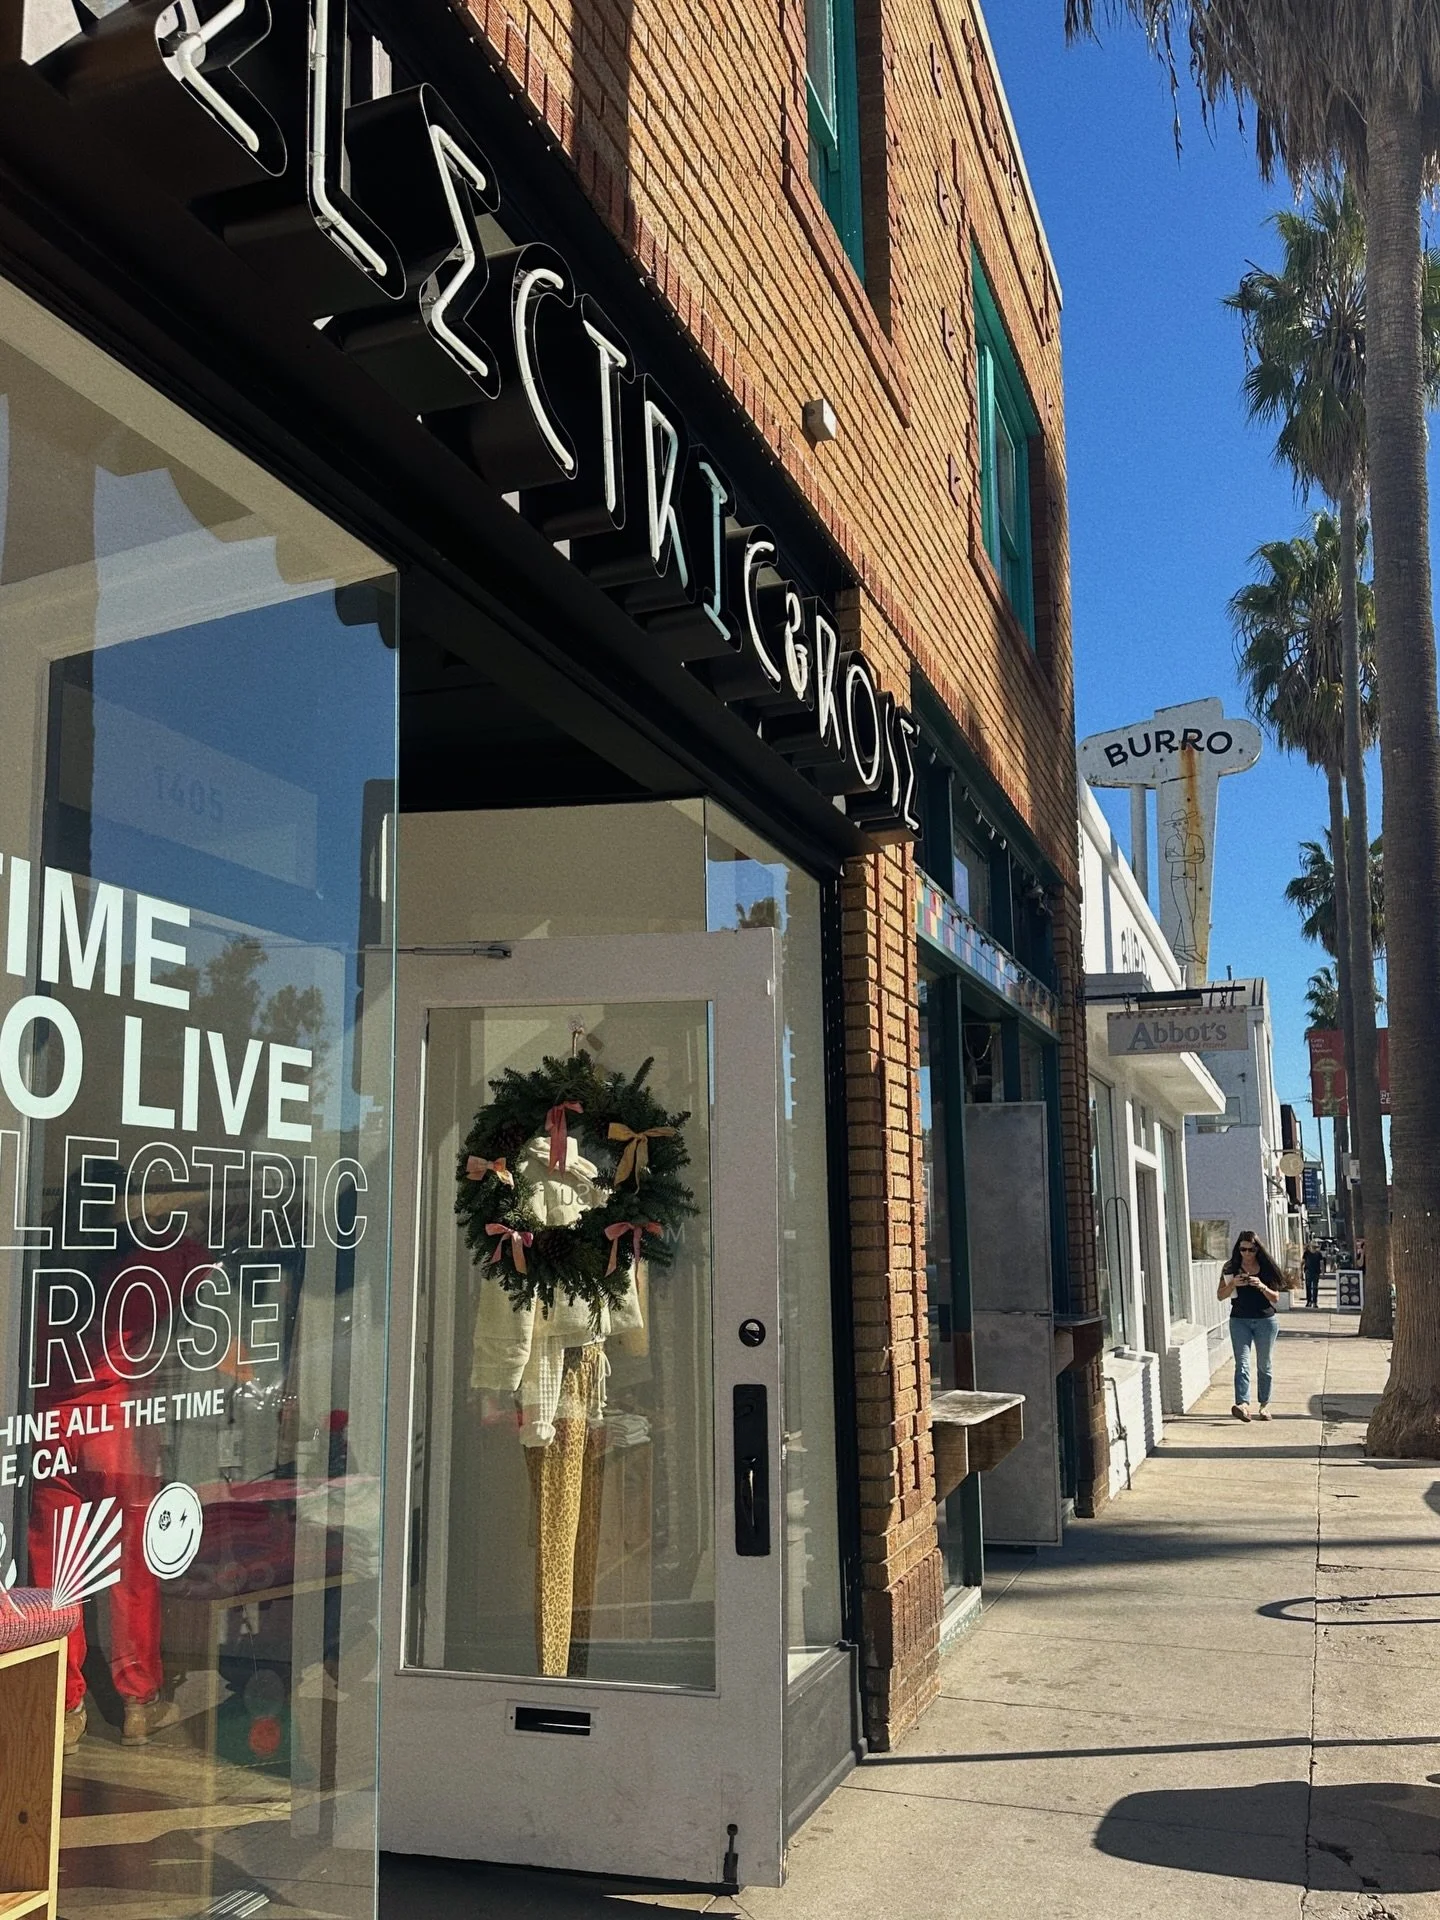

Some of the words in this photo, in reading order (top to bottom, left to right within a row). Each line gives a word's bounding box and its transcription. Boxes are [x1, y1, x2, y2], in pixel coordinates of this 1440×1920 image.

[1104, 728, 1232, 768] BURRO
[0, 852, 190, 1011] IME
[1127, 1020, 1227, 1050] Abbot's
[122, 1015, 312, 1142] LIVE
[28, 1264, 281, 1388] ROSE
[66, 1403, 114, 1437] ALL
[120, 1396, 166, 1428] THE
[172, 1388, 225, 1420] TIME
[1, 1453, 25, 1487] E,
[32, 1446, 77, 1480] CA.
